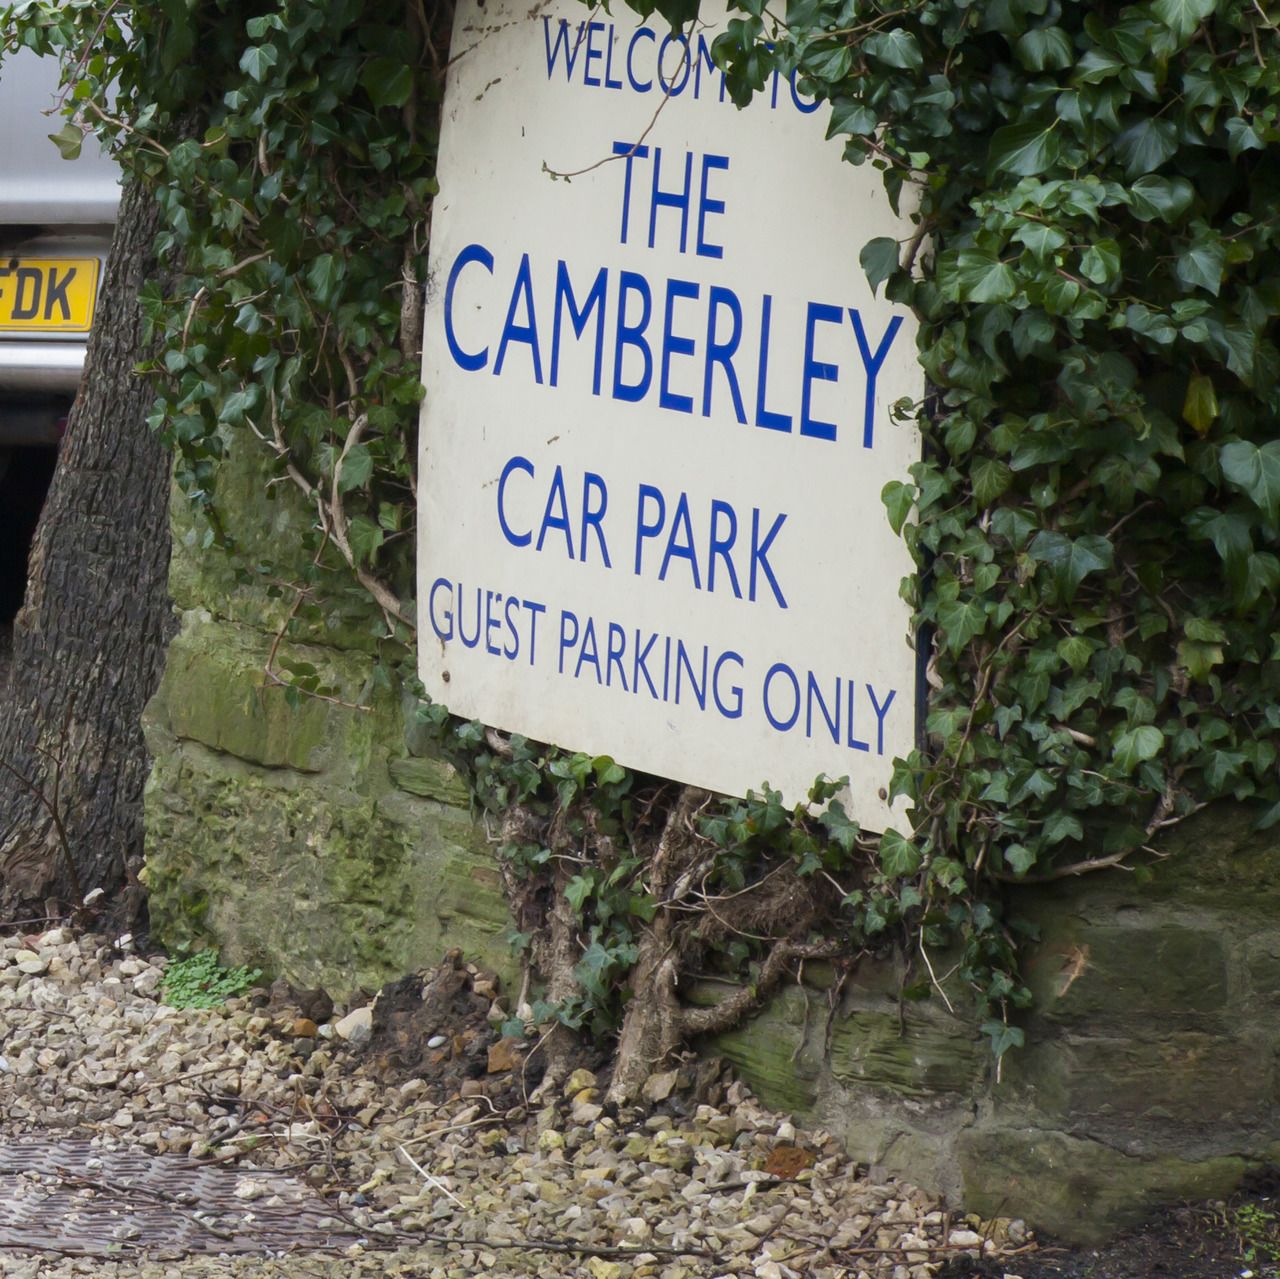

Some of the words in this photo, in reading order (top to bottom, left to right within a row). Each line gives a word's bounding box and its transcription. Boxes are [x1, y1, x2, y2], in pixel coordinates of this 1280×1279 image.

[543, 16, 743, 104] WELCOM
[611, 141, 731, 260] THE
[443, 243, 904, 450] CAMBERLEY
[496, 455, 612, 569] CAR
[634, 482, 789, 610] PARK
[429, 577, 547, 666] GUEST
[558, 610, 745, 719] PARKING
[762, 662, 897, 756] ONLY
